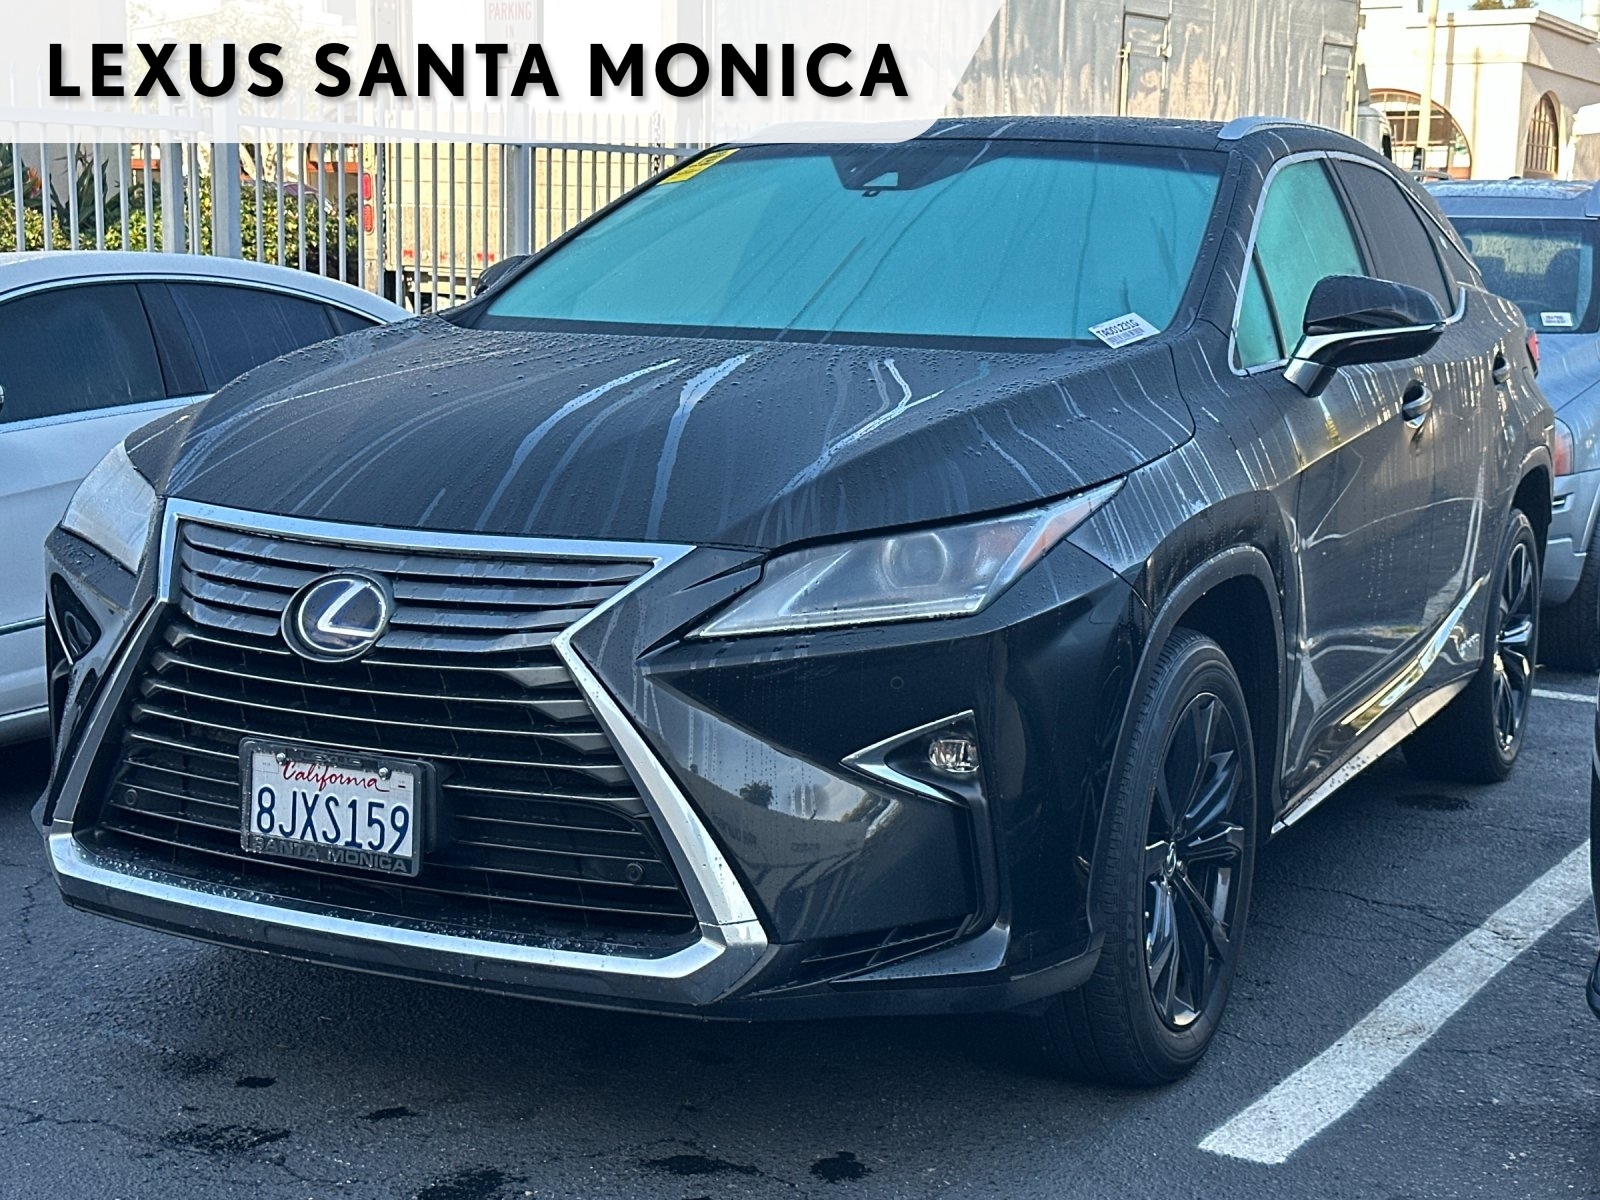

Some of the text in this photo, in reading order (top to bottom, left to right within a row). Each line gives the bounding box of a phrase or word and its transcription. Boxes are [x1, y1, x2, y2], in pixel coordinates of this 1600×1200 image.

[488, 2, 532, 21] PARKING
[505, 24, 515, 39] IN
[282, 760, 390, 792] California
[256, 786, 410, 855] 8JXS159
[252, 835, 408, 873] SANTA MONICA
